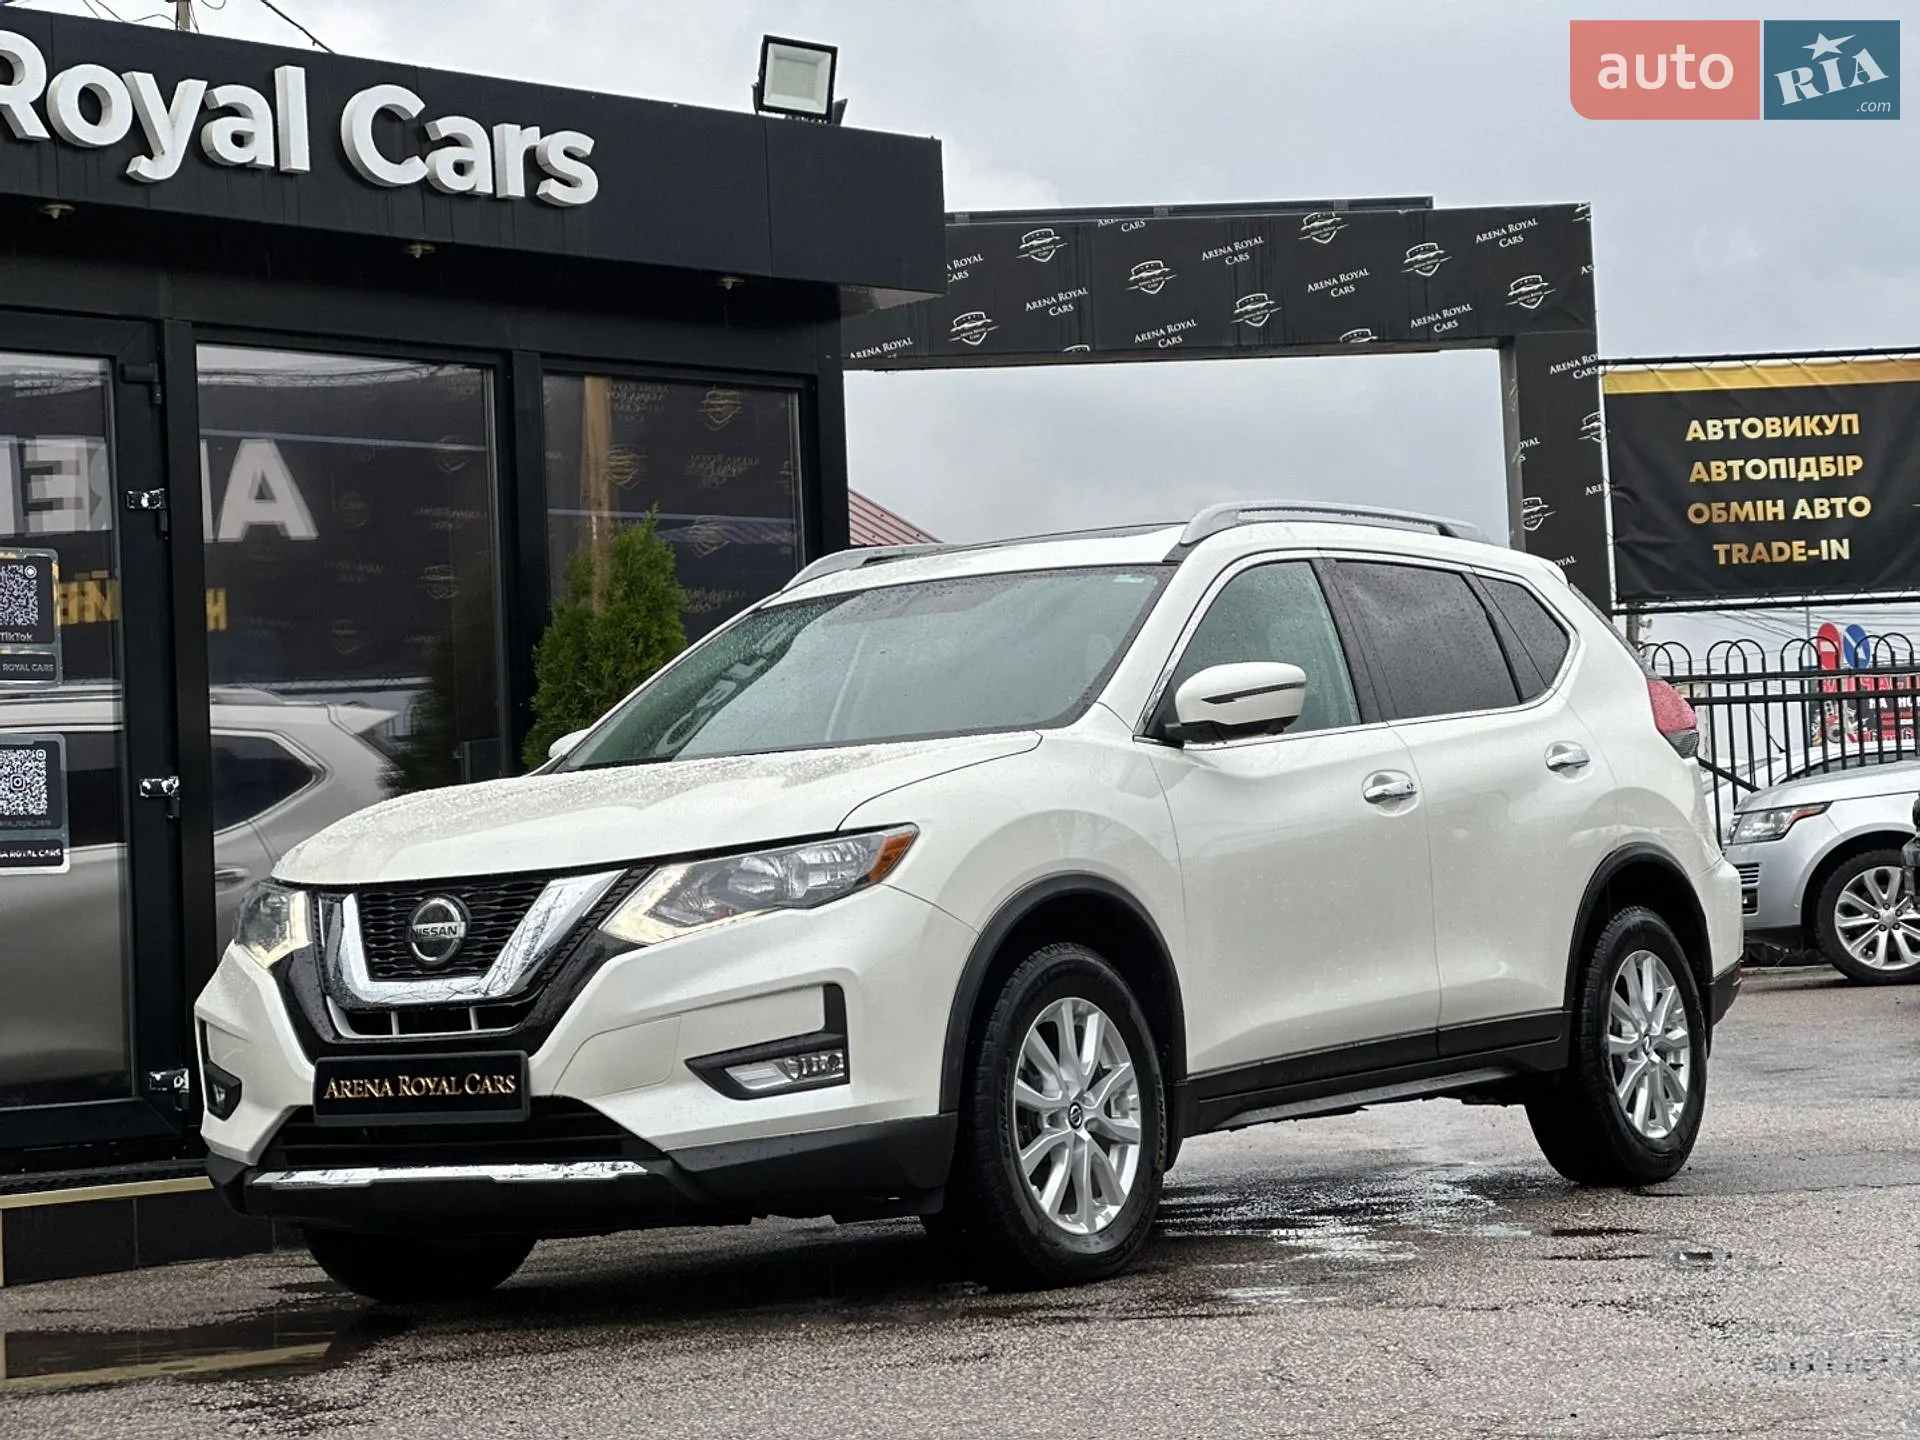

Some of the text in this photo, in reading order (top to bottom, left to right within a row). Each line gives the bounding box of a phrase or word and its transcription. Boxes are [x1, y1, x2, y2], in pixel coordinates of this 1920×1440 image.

[0, 29, 599, 207] Royal Cars
[1120, 219, 1146, 232] CARS
[1475, 217, 1539, 244] ARENA ROYAL
[1201, 236, 1265, 261] ARENA ROYAL
[1498, 233, 1525, 248] CARS
[952, 253, 984, 269] ROYAL
[1225, 252, 1250, 265] CARS
[1307, 268, 1370, 293] ARENA ROYAL
[1330, 284, 1356, 298] CARS
[1025, 286, 1089, 312] ARENA ROYAL
[1048, 303, 1074, 316] CARS
[1410, 303, 1473, 329] ARENA ROYAL
[1433, 319, 1459, 333] CARS
[1134, 318, 1199, 344] ARENA ROYAL
[1158, 334, 1183, 348] CARS
[849, 347, 882, 360] ARENA
[881, 336, 914, 353] ROYAL
[1550, 359, 1581, 375] ARENA
[1685, 413, 1860, 442] АВТОВИКУП
[1689, 455, 1864, 483] АВТОПІДБІР
[1687, 495, 1872, 525] ОБМІН АВТО
[1712, 538, 1850, 565] TRADE-IN
[0, 631, 33, 642] TikTok
[2, 662, 30, 672] ROYAL
[408, 925, 458, 940] NISSAN
[324, 1072, 516, 1100] ARENA ROYAL CARS
